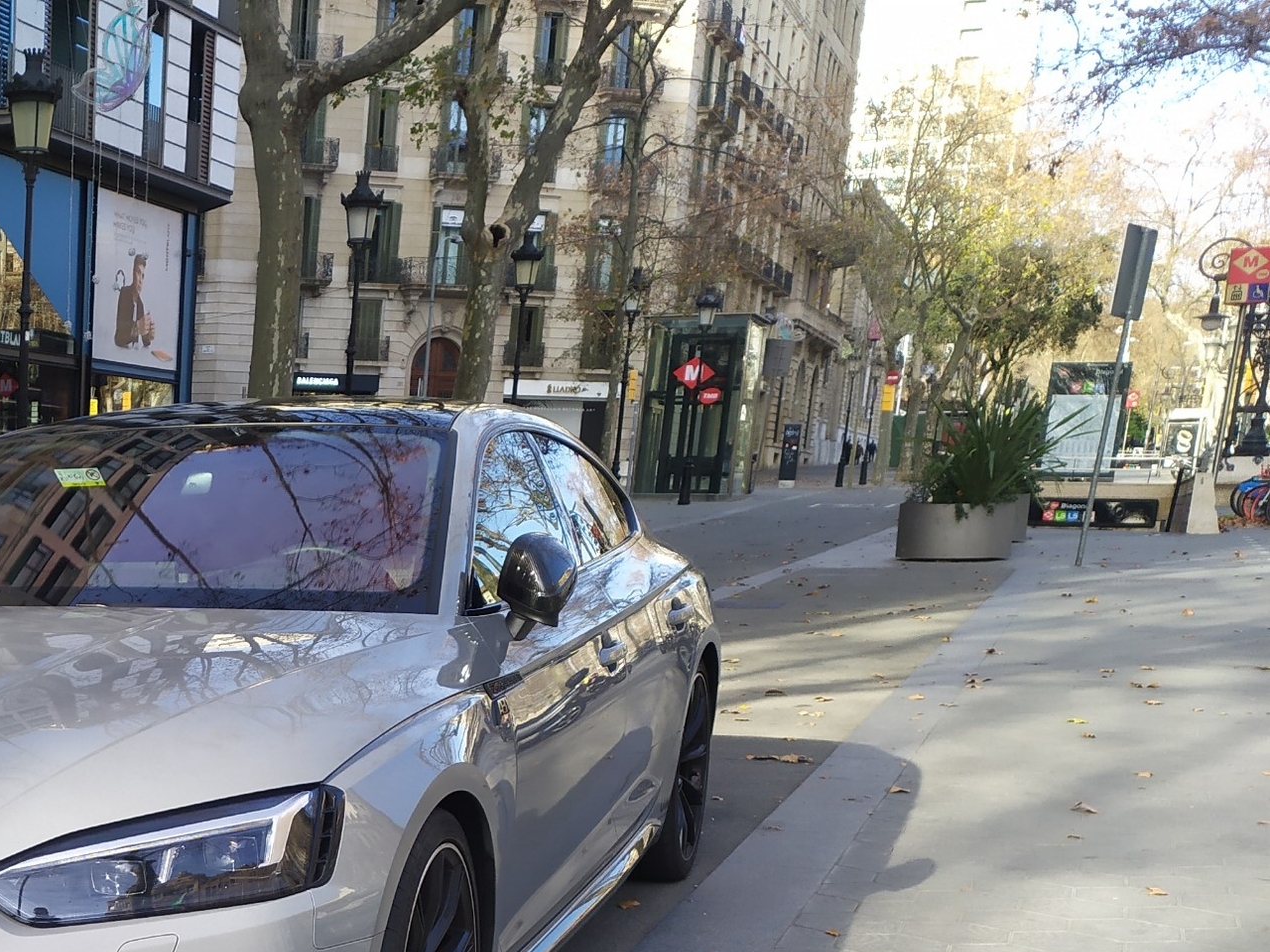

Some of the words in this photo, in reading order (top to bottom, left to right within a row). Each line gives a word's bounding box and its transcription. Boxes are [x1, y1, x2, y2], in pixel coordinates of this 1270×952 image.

[1243, 255, 1259, 268] M
[685, 364, 704, 381] M
[296, 376, 339, 386] BALENCIAGA
